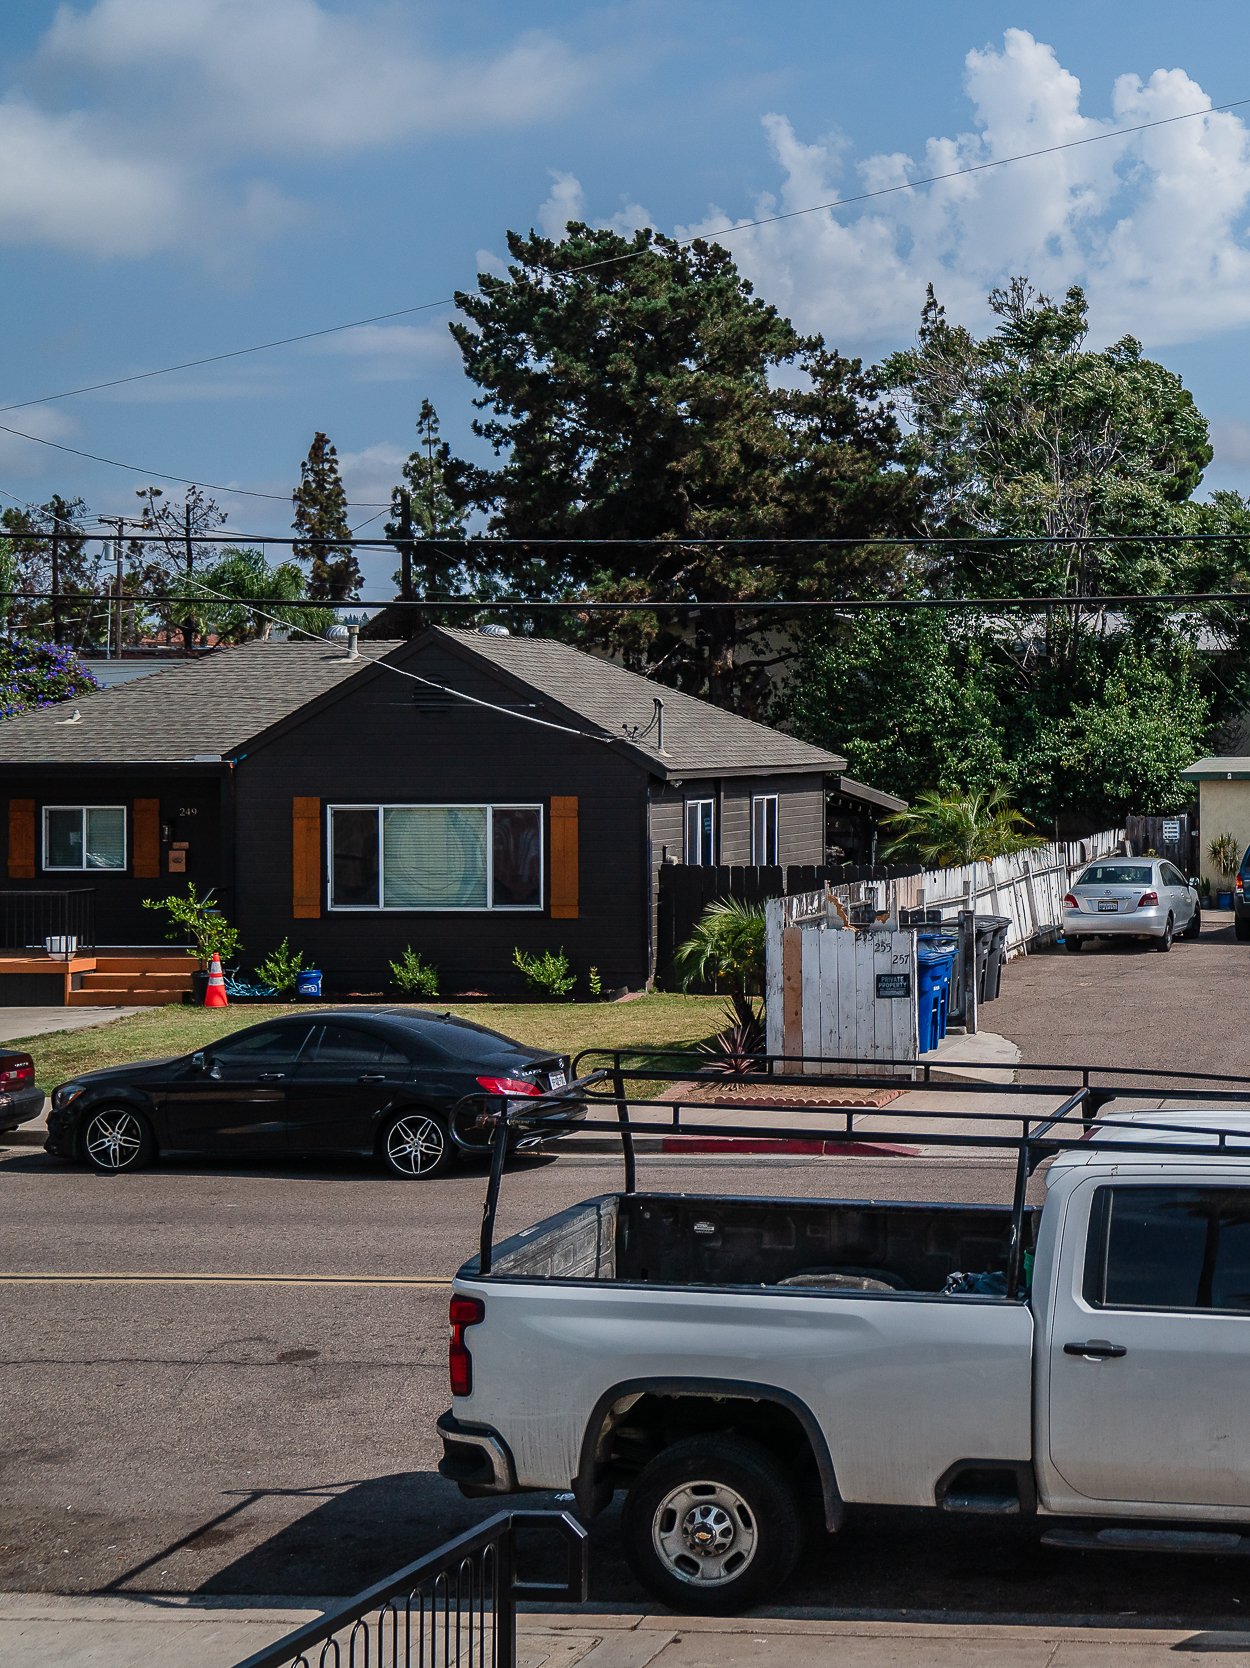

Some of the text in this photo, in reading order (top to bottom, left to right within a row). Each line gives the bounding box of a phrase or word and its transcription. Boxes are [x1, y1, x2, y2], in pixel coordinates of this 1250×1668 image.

[179, 807, 198, 817] 249
[874, 942, 892, 953] 255
[892, 954, 910, 964] 257
